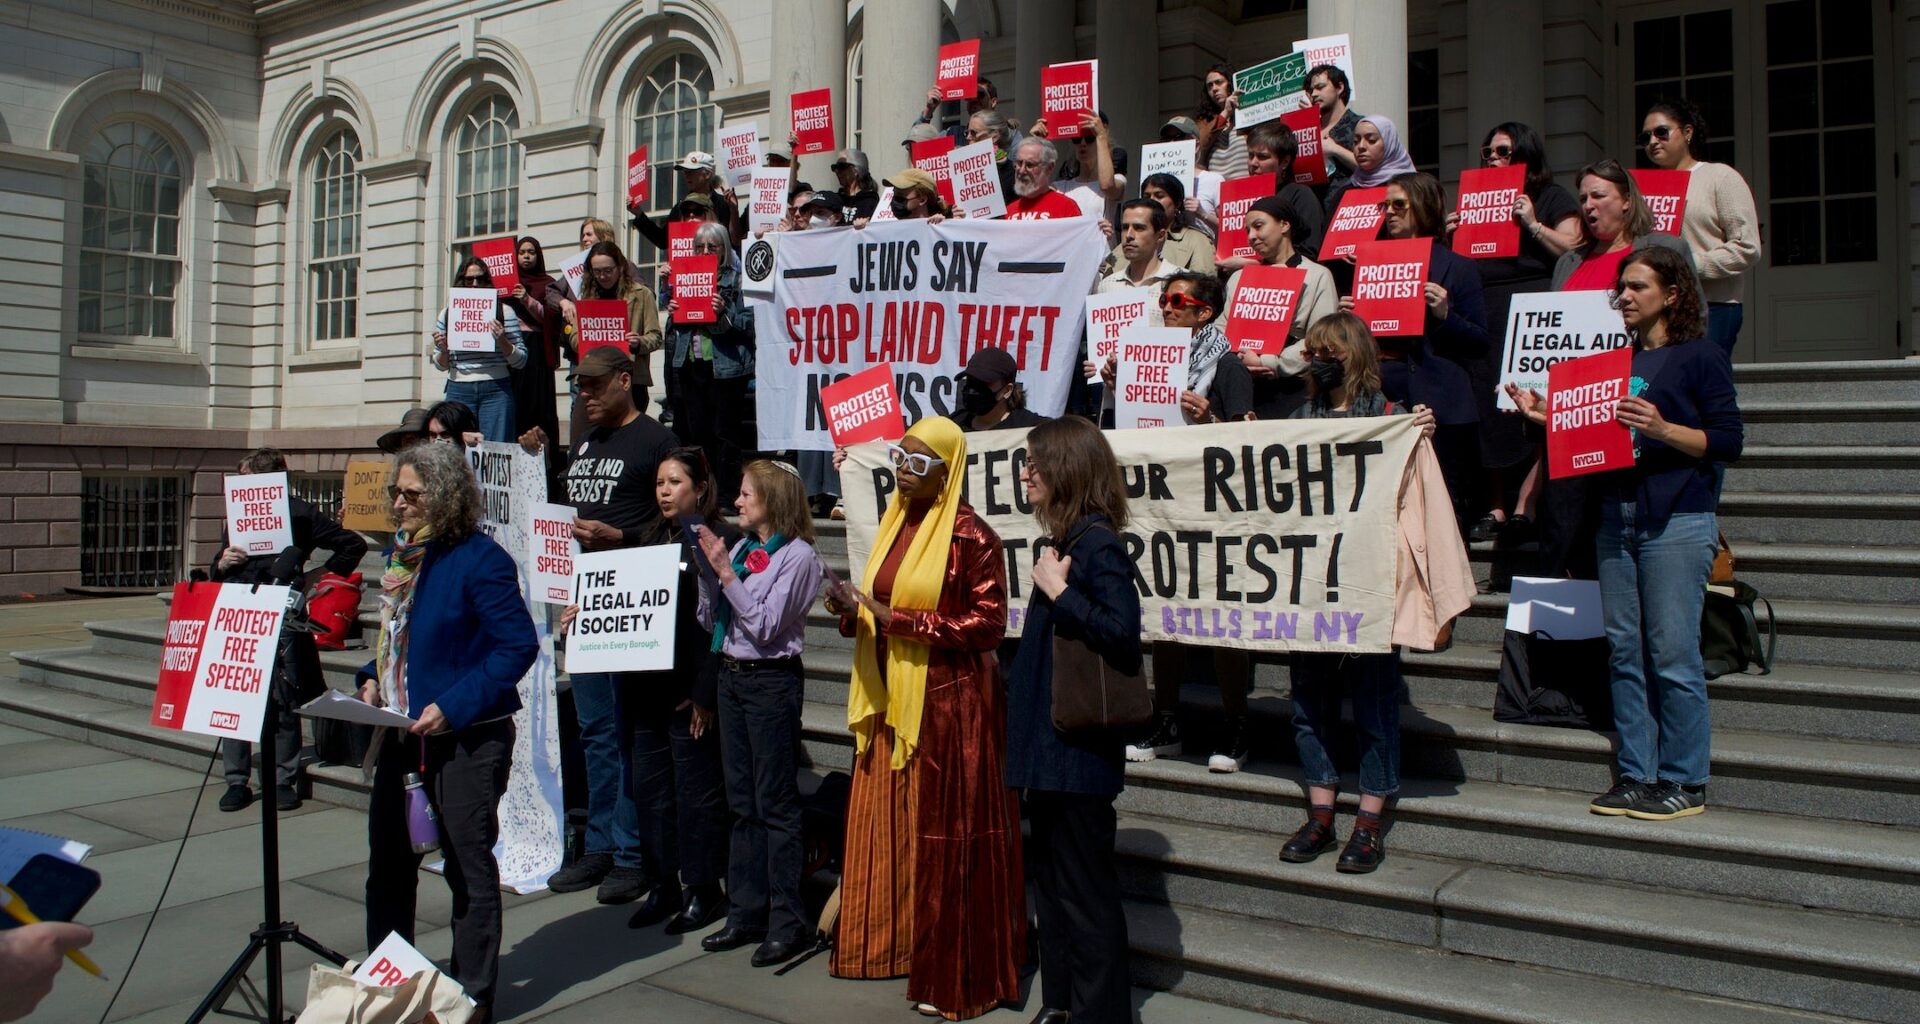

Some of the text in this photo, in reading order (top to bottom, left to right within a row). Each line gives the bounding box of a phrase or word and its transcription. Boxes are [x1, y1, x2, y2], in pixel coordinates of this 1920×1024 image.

[940, 54, 975, 69] PROTECT
[1306, 45, 1346, 60] ROTECT
[939, 65, 974, 80] PROTEST
[1044, 82, 1088, 99] PROTECT
[794, 105, 828, 120] PROTECT
[1045, 96, 1088, 112] PROTEST
[794, 118, 828, 132] PROTEST
[721, 132, 756, 148] PROTECT
[730, 144, 750, 158] FREE
[1162, 150, 1182, 158] YOU
[1298, 141, 1318, 158] TEST
[728, 154, 756, 170] SPEECH
[953, 152, 992, 175] PROTECT
[754, 178, 787, 190] PROTECT
[964, 168, 986, 186] FREE
[760, 190, 778, 202] FREE
[960, 182, 996, 202] SPEECH
[1461, 188, 1518, 208] PROTECT
[754, 202, 782, 214] SPEECH
[1222, 198, 1260, 217] PROT
[1642, 195, 1680, 213] TECT
[1331, 216, 1381, 232] PROTEST
[1459, 206, 1514, 226] PROTEST
[672, 238, 694, 250] PROT
[1472, 243, 1496, 254] NYCLU
[482, 253, 513, 267] ROTECT
[850, 239, 988, 294] JEWS SAY
[490, 264, 514, 277] OTEST
[676, 272, 714, 285] PROTECT
[1358, 262, 1423, 282] PROTECT
[676, 286, 714, 298] PROTEST
[1237, 286, 1295, 306] PROTECT
[1357, 280, 1421, 300] PROTEST
[453, 298, 494, 310] PROTECT
[1092, 302, 1145, 324] PROTECT
[1232, 302, 1290, 322] PROTEST
[462, 310, 484, 320] FREE
[580, 318, 624, 330] PROTECT
[1525, 311, 1563, 328] THE
[454, 322, 490, 332] SPEECH
[1105, 320, 1133, 339] FR
[1371, 320, 1399, 332] NYCLU
[582, 330, 626, 342] PROTEST
[785, 300, 1061, 372] STOP LAND THEFT
[1522, 334, 1629, 350] LEGAL AID
[1096, 340, 1118, 357] SPE
[1124, 344, 1186, 364] PROTECT
[1136, 365, 1170, 384] FREE
[829, 383, 890, 421] PROTECT
[1125, 384, 1177, 404] SPEECH
[1552, 378, 1624, 412] PROTECT
[834, 398, 893, 436] PROTEST
[1552, 399, 1621, 433] PROTEST
[594, 458, 625, 478] AND
[1572, 451, 1605, 468] NYCLU
[1120, 463, 1174, 500] UR
[1203, 440, 1383, 517] RIGHT
[232, 486, 284, 503] PROTECT
[244, 502, 272, 517] FREE
[236, 516, 282, 533] SPEECH
[534, 518, 575, 540] PROTEC
[544, 538, 570, 558] FREE
[1120, 529, 1344, 605] ROTEST!
[585, 570, 616, 589] THE
[582, 588, 670, 612] LEGAL AID
[214, 608, 280, 637] PROTECT
[580, 614, 654, 635] SOCIETY
[1162, 607, 1246, 638] BILLS
[1252, 609, 1305, 641] IN
[1314, 611, 1366, 646] NY
[166, 620, 206, 644] PROTECT
[222, 636, 258, 664] FREE
[579, 638, 661, 652] Justice in Every Borough.
[162, 647, 198, 672] PROTEST
[206, 662, 262, 694] SPEECH
[210, 712, 240, 730] NYCLU
